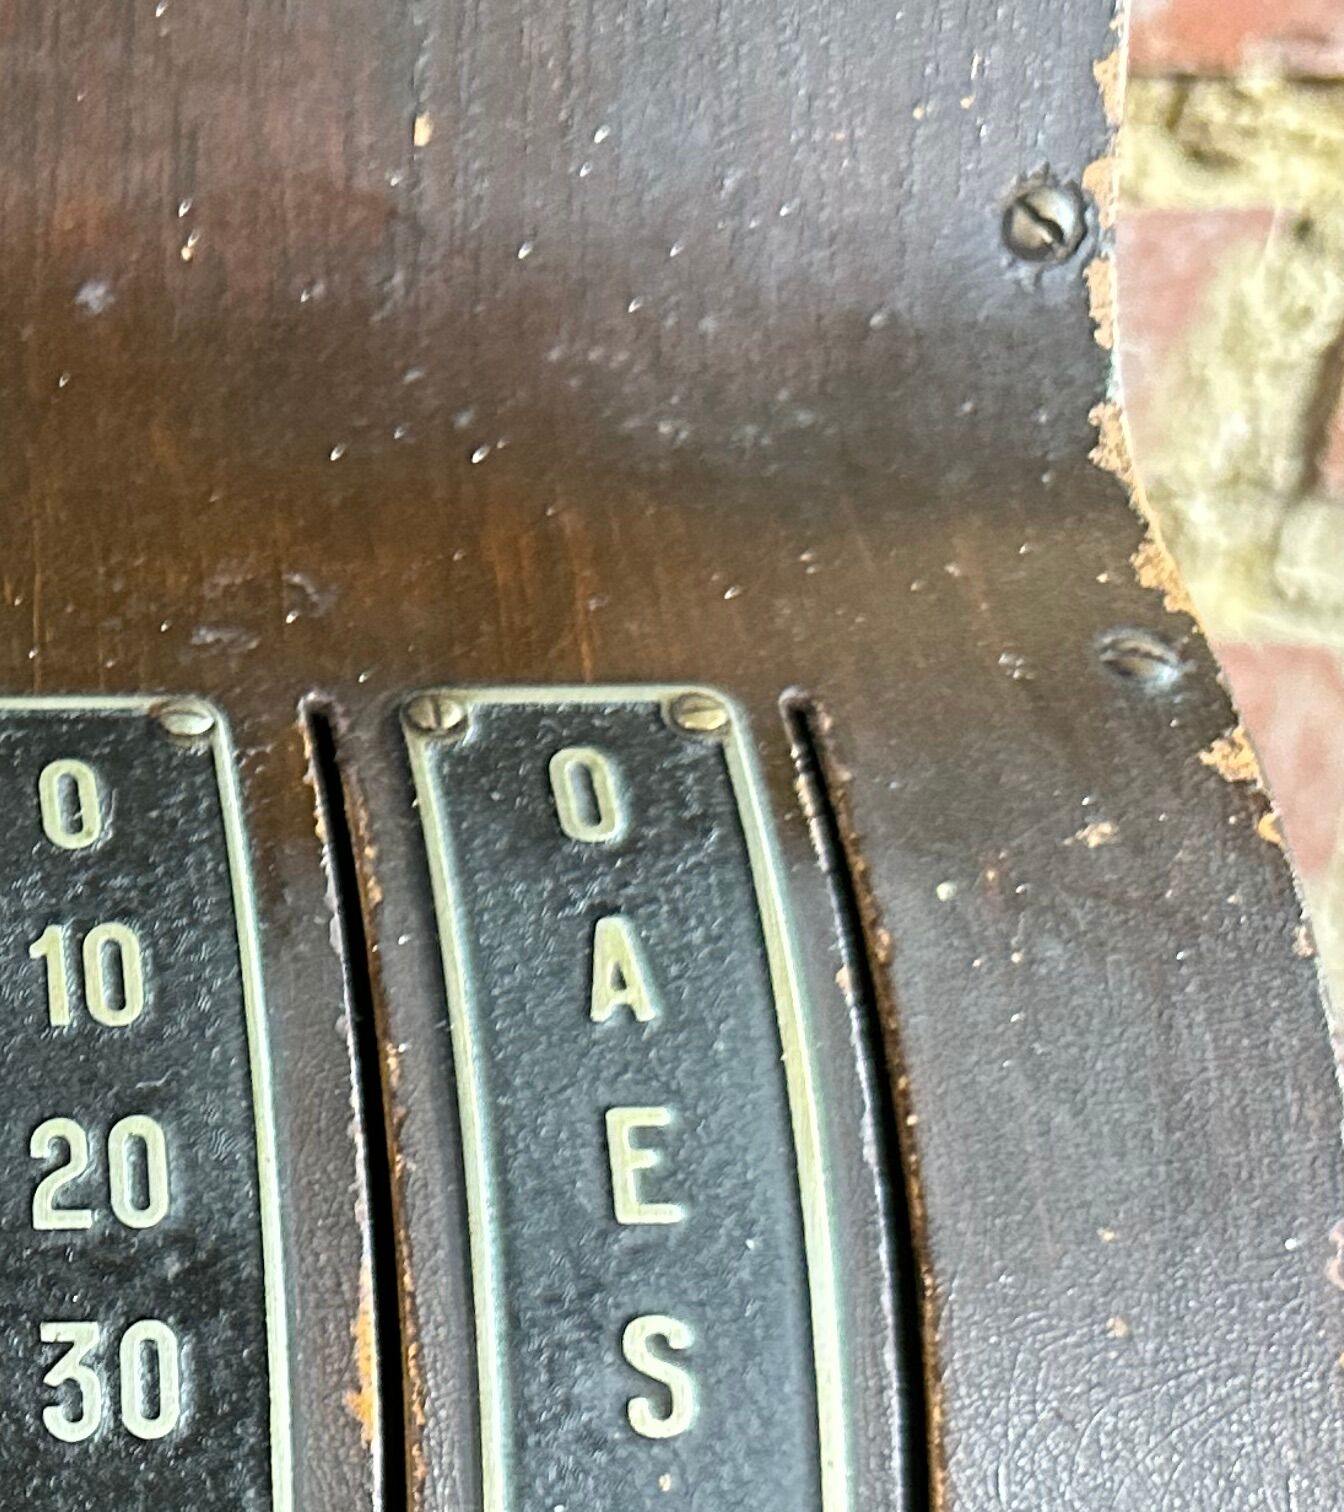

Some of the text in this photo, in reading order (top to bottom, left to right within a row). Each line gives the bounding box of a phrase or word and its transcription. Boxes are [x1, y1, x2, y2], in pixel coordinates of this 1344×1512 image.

[37, 759, 100, 849] 0
[28, 923, 144, 1027] 10
[590, 917, 655, 1024] A
[28, 1114, 169, 1230] 20
[605, 1106, 683, 1226] E
[39, 1319, 180, 1442] 30
[621, 1314, 694, 1440] S
